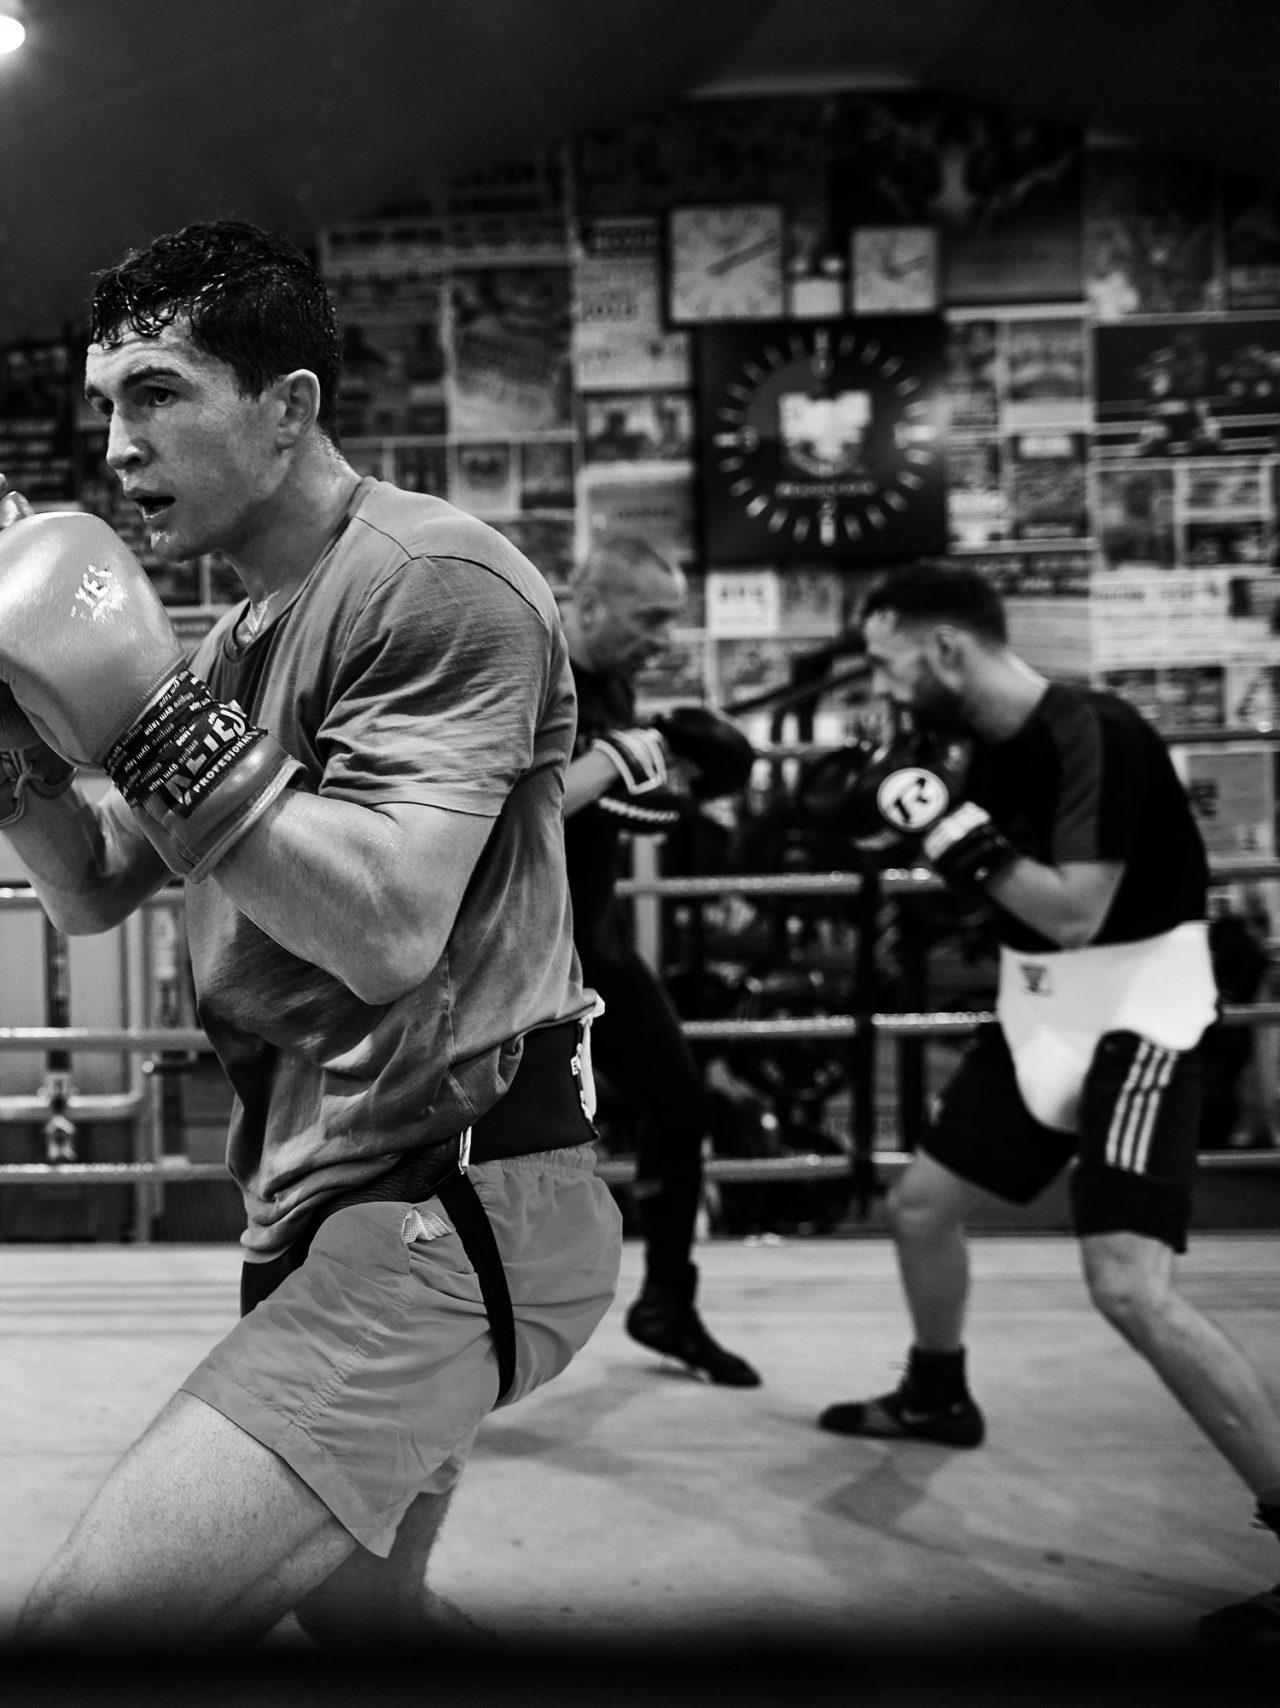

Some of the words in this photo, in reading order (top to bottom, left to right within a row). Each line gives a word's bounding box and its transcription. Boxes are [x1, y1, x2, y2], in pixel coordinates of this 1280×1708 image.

[159, 706, 174, 721] gym
[144, 720, 160, 736] tape
[136, 744, 150, 760] gym
[178, 739, 199, 764] empire
[162, 763, 179, 779] gym
[148, 778, 165, 792] tape
